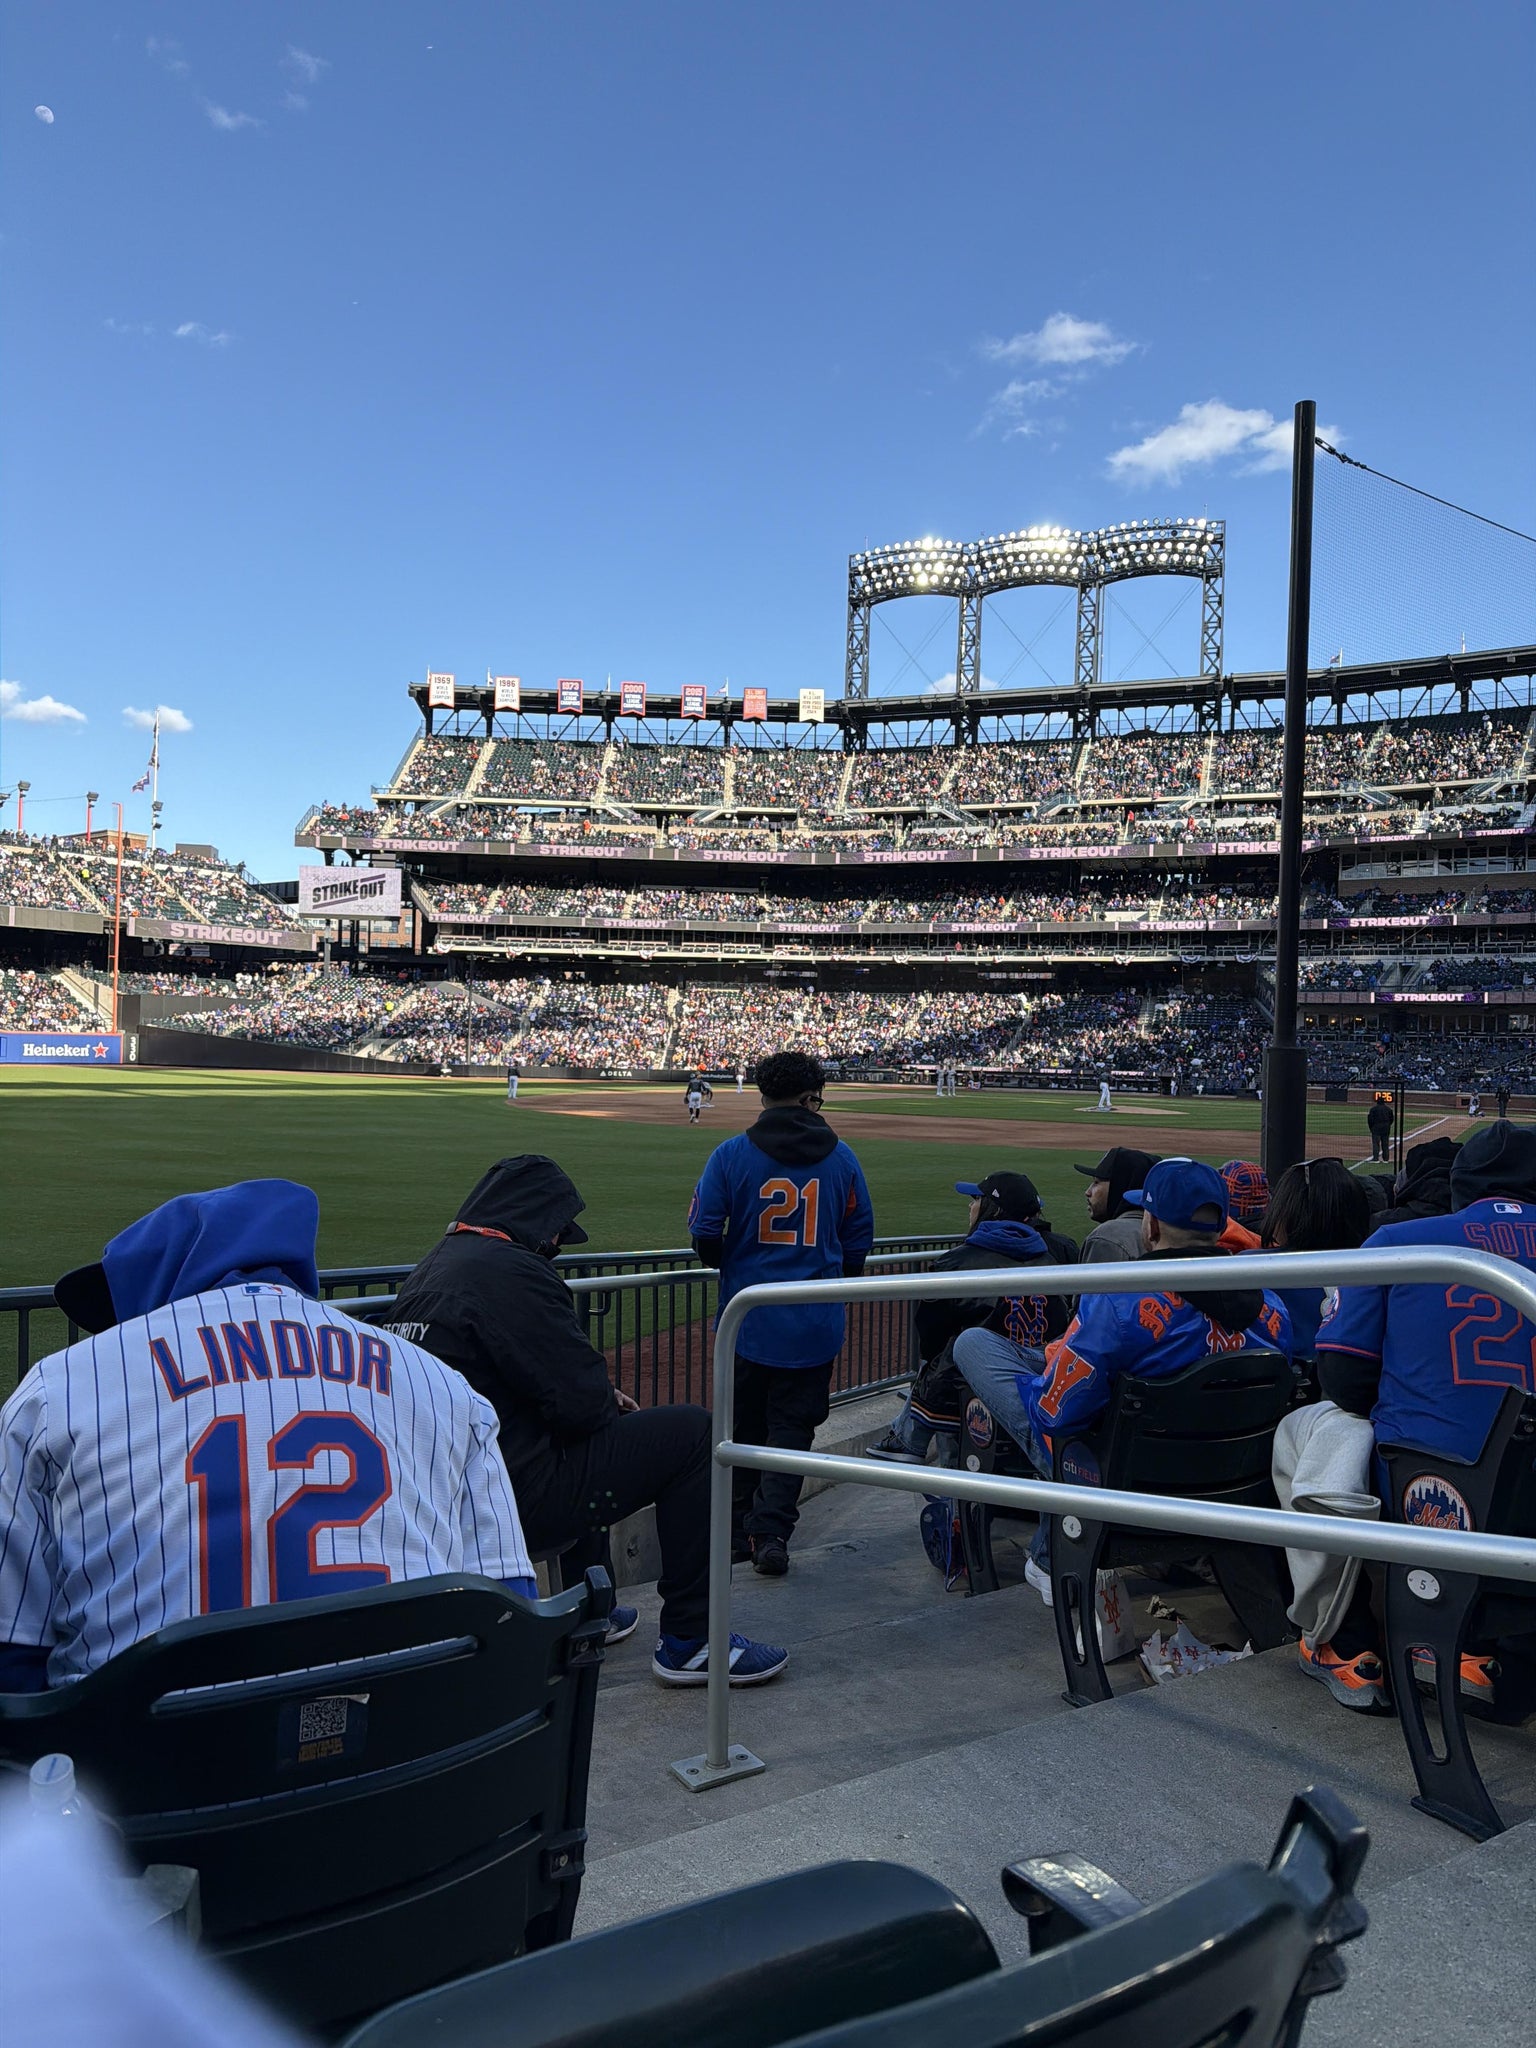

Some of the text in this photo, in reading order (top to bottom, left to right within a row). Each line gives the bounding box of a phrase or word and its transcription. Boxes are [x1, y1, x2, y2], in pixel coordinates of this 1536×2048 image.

[434, 676, 451, 684] 1969
[562, 682, 579, 690] 1973
[624, 684, 642, 692] 2000
[686, 688, 702, 696] 2015
[1476, 828, 1526, 836] STRIKEOUT
[1370, 834, 1416, 842] STRIKEOUT
[372, 838, 460, 851] STRIKEOUT
[540, 845, 625, 856] STRIKEOUT
[703, 850, 788, 862] STRIKEOUT
[864, 850, 948, 862] STRIKEOUT
[1029, 846, 1122, 859] STRIKEOUT
[312, 879, 386, 903] STRIKE OUT
[604, 918, 668, 928] STRIKEOUT
[1350, 916, 1430, 927] STRIKEOUT
[778, 923, 842, 932] STRIKEOUT
[951, 923, 1018, 932] STRIKEOUT
[170, 922, 282, 945] STRIKEOUT
[1394, 993, 1464, 1002] STRIKEOUT
[23, 1044, 91, 1056] Heineken
[757, 1177, 820, 1246] 21
[149, 1319, 392, 1402] LINDOR
[1063, 1460, 1099, 1483] citi FIELD
[185, 1410, 392, 1614] 12
[1069, 1522, 1074, 1532] 4
[1419, 1580, 1426, 1590] 5
